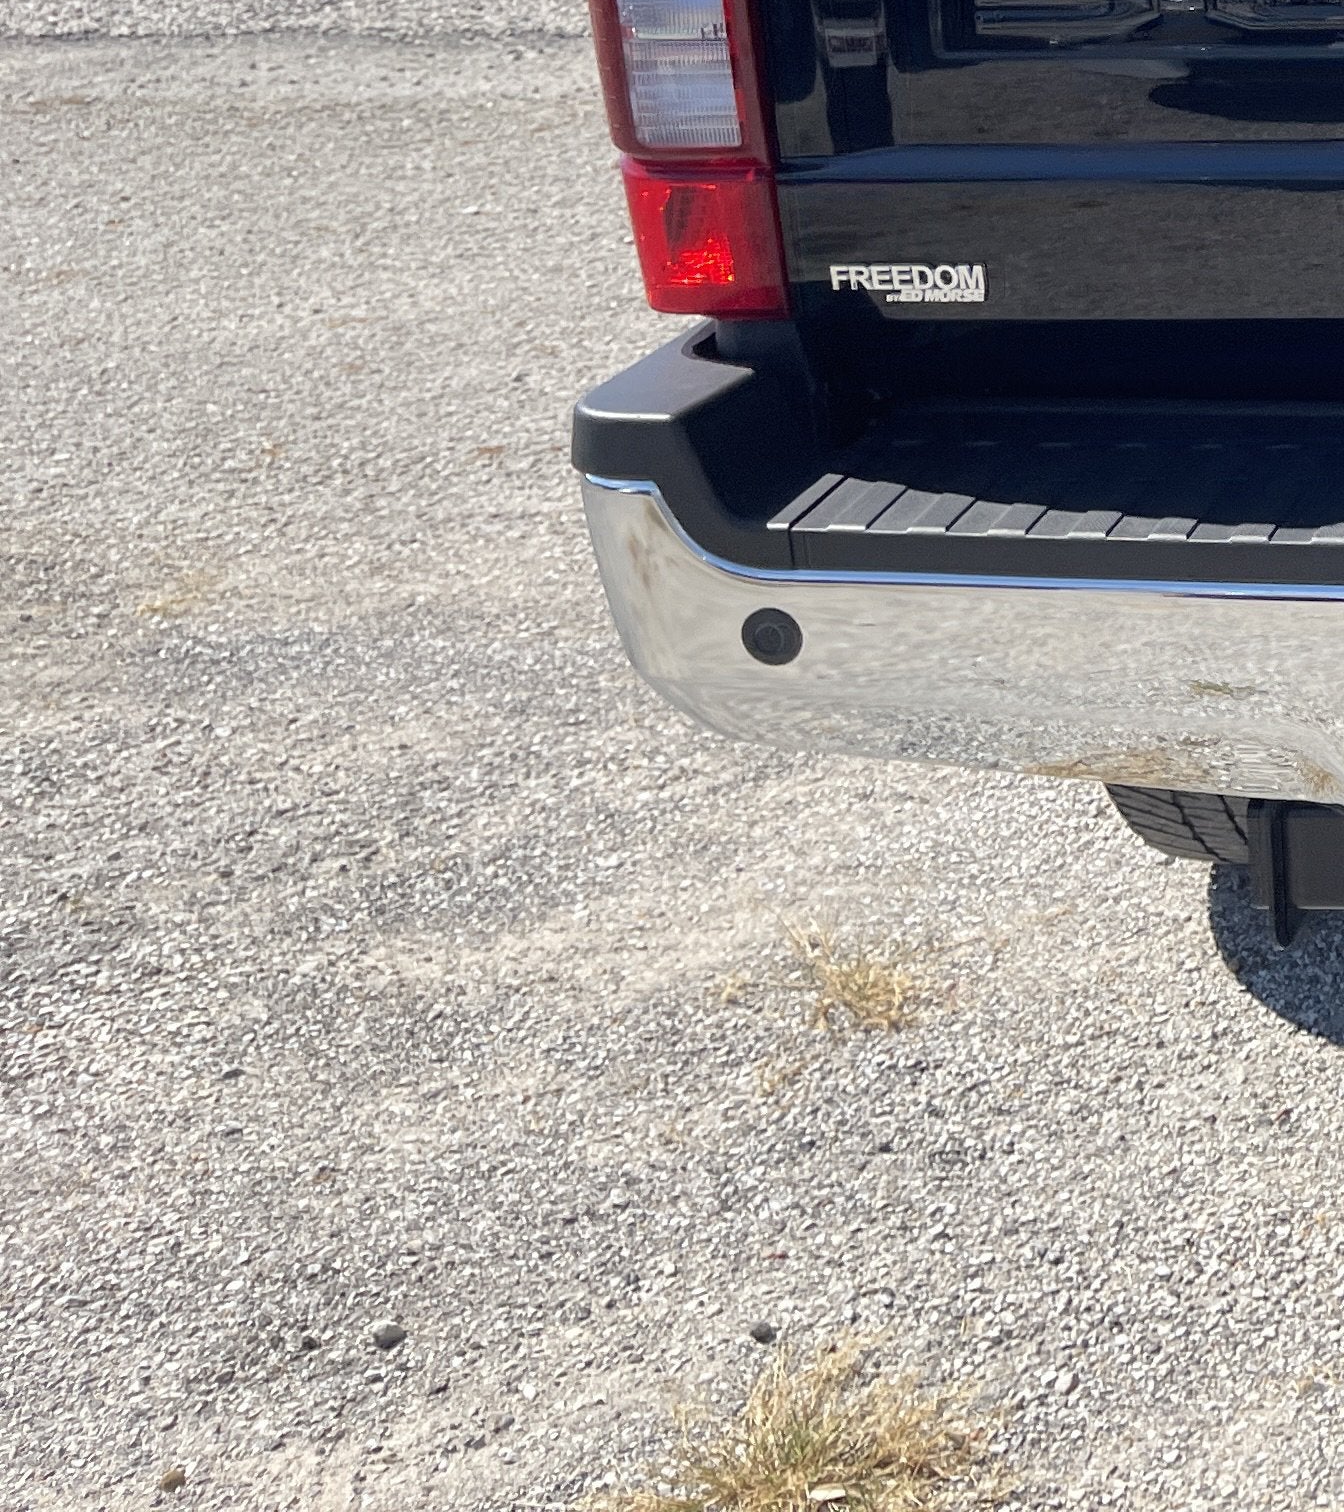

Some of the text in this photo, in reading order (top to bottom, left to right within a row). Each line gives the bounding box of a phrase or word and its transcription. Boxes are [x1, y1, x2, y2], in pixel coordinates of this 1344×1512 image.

[829, 264, 986, 291] FREEDOM
[900, 289, 924, 302] ED
[924, 288, 985, 302] MORSE
